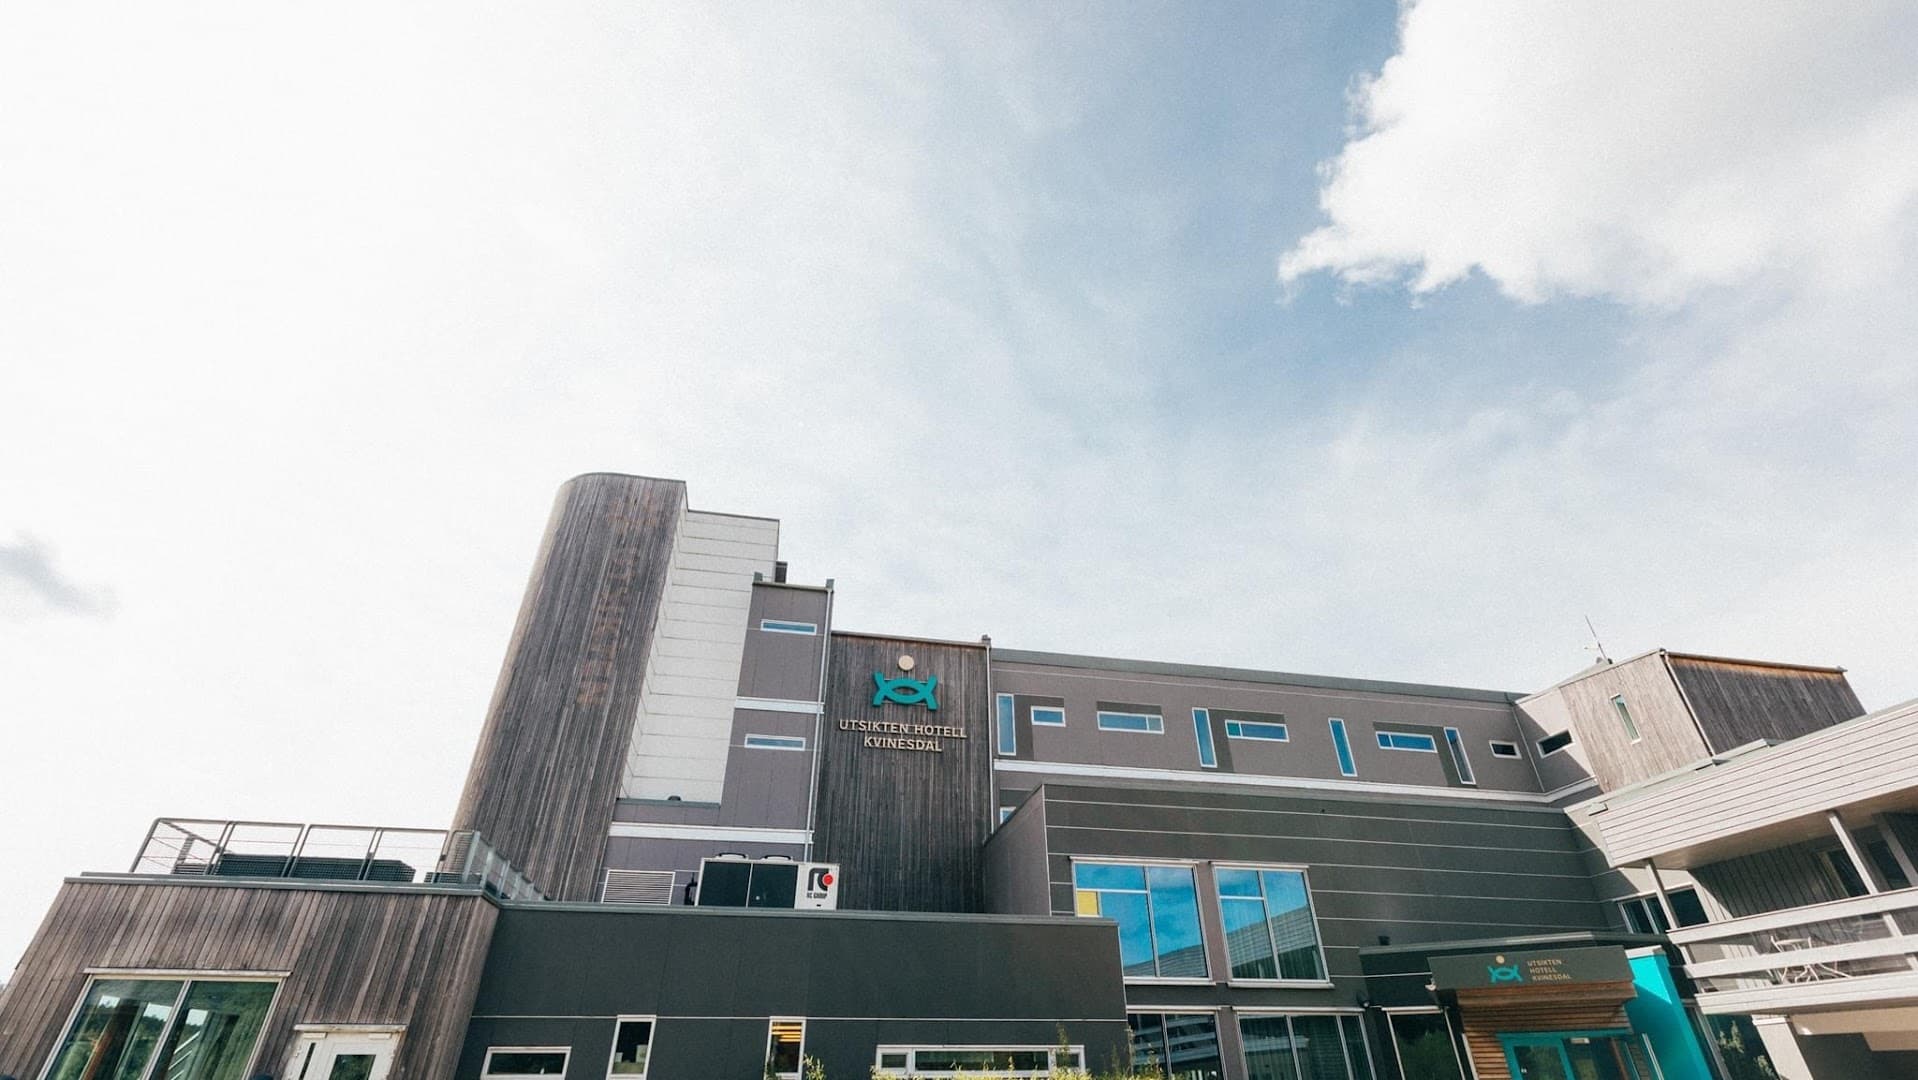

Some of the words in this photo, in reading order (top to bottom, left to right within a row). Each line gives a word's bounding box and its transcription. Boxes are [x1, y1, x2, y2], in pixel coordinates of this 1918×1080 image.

[839, 719, 909, 734] UTSIKTEN
[914, 724, 968, 738] HOTELL
[863, 735, 943, 752] KVINESDAL
